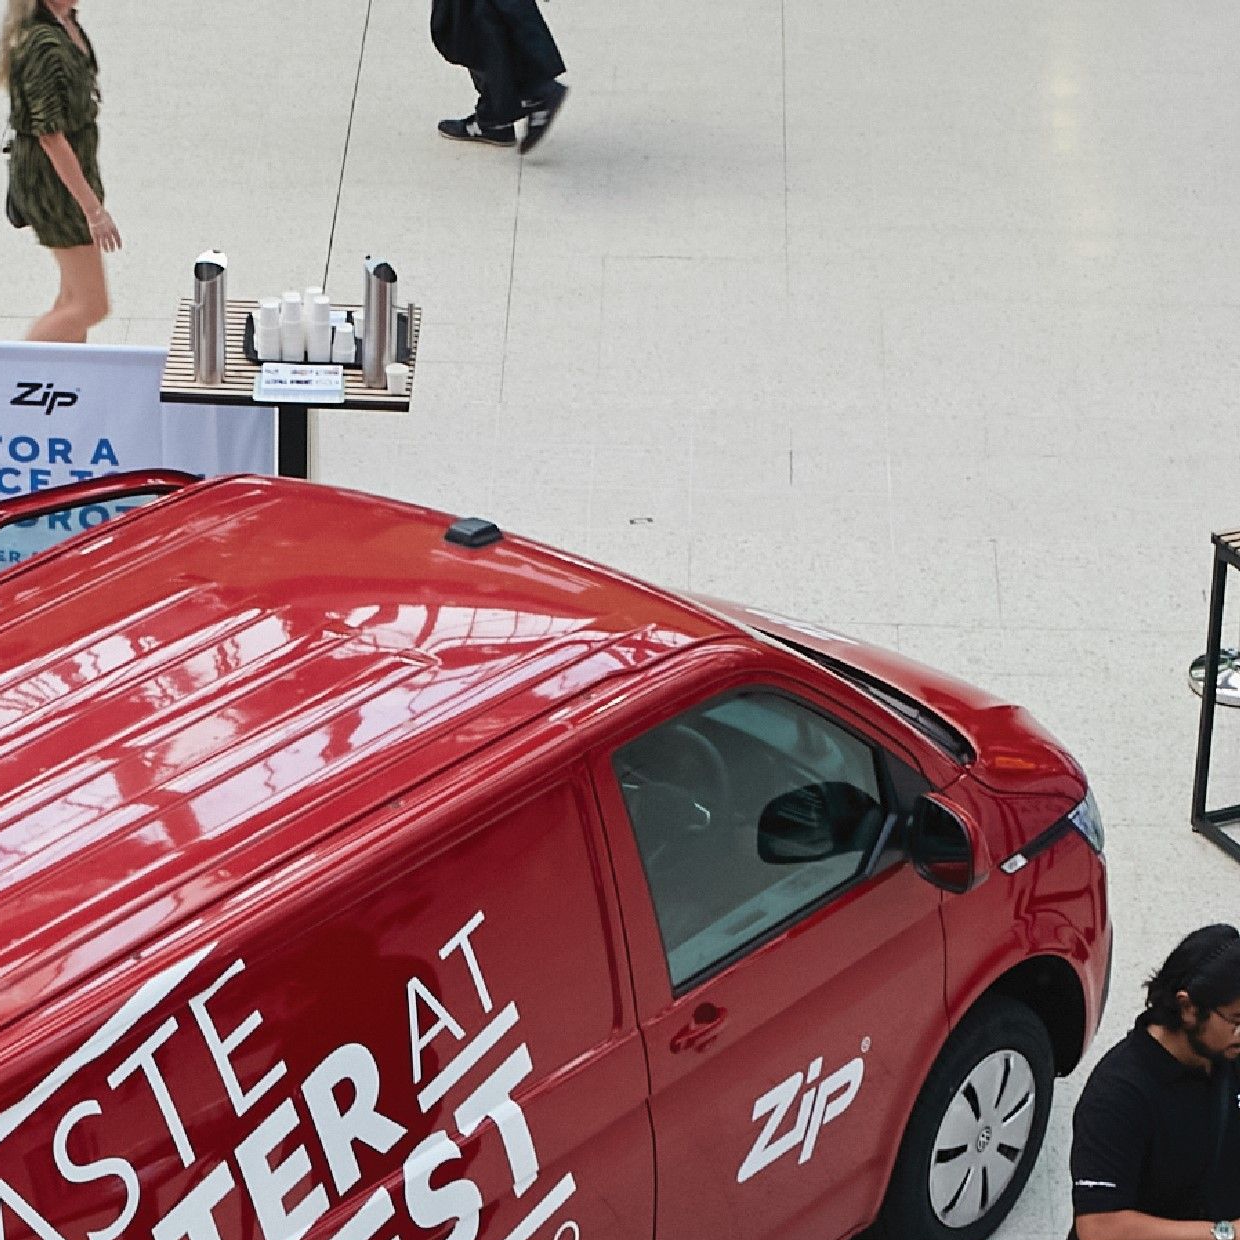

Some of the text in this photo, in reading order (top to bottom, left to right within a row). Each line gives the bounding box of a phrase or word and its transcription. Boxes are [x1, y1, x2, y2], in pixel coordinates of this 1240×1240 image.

[9, 382, 79, 415] Zip
[90, 438, 120, 466] A
[405, 910, 496, 1084] AT
[737, 1056, 864, 1183] Zip
